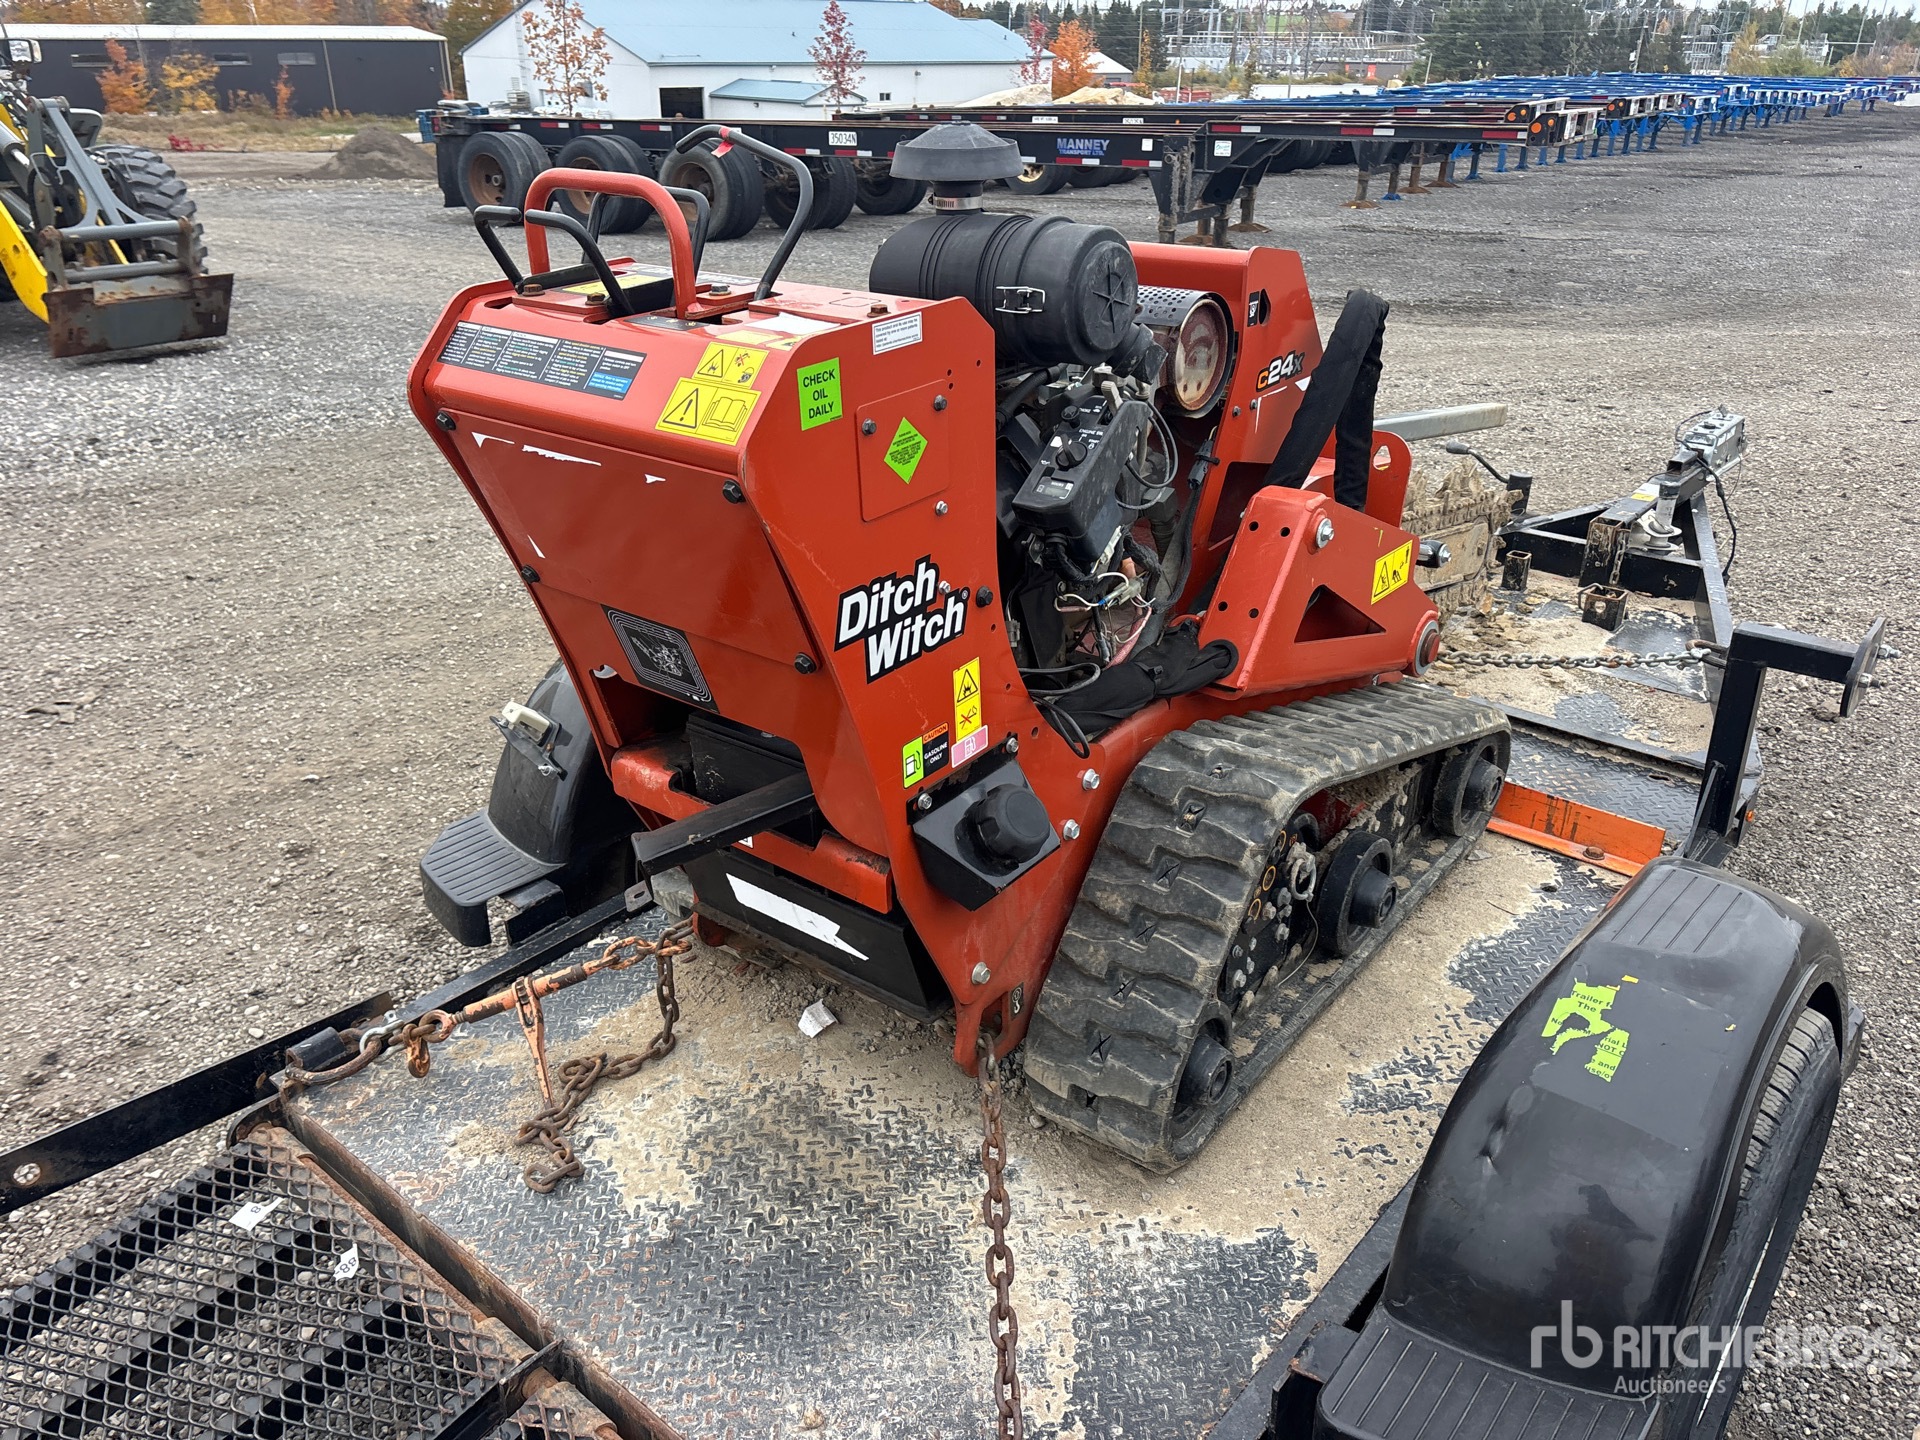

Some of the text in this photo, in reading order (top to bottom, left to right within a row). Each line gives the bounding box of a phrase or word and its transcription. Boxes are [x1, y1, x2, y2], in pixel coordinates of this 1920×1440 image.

[830, 132, 857, 144] 35034N
[1056, 138, 1110, 150] MANNEY
[1059, 148, 1092, 156] TRANSPORT
[802, 368, 836, 388] CHECK
[812, 387, 829, 402] OIL
[808, 400, 835, 420] DAILY
[838, 561, 937, 644] Ditch
[923, 724, 948, 742] CAUTION
[923, 741, 948, 760] GASOLINE
[929, 751, 943, 764] ONLY
[1571, 990, 1603, 1005] Trailer
[1577, 1000, 1597, 1013] The
[1597, 1059, 1617, 1071] and
